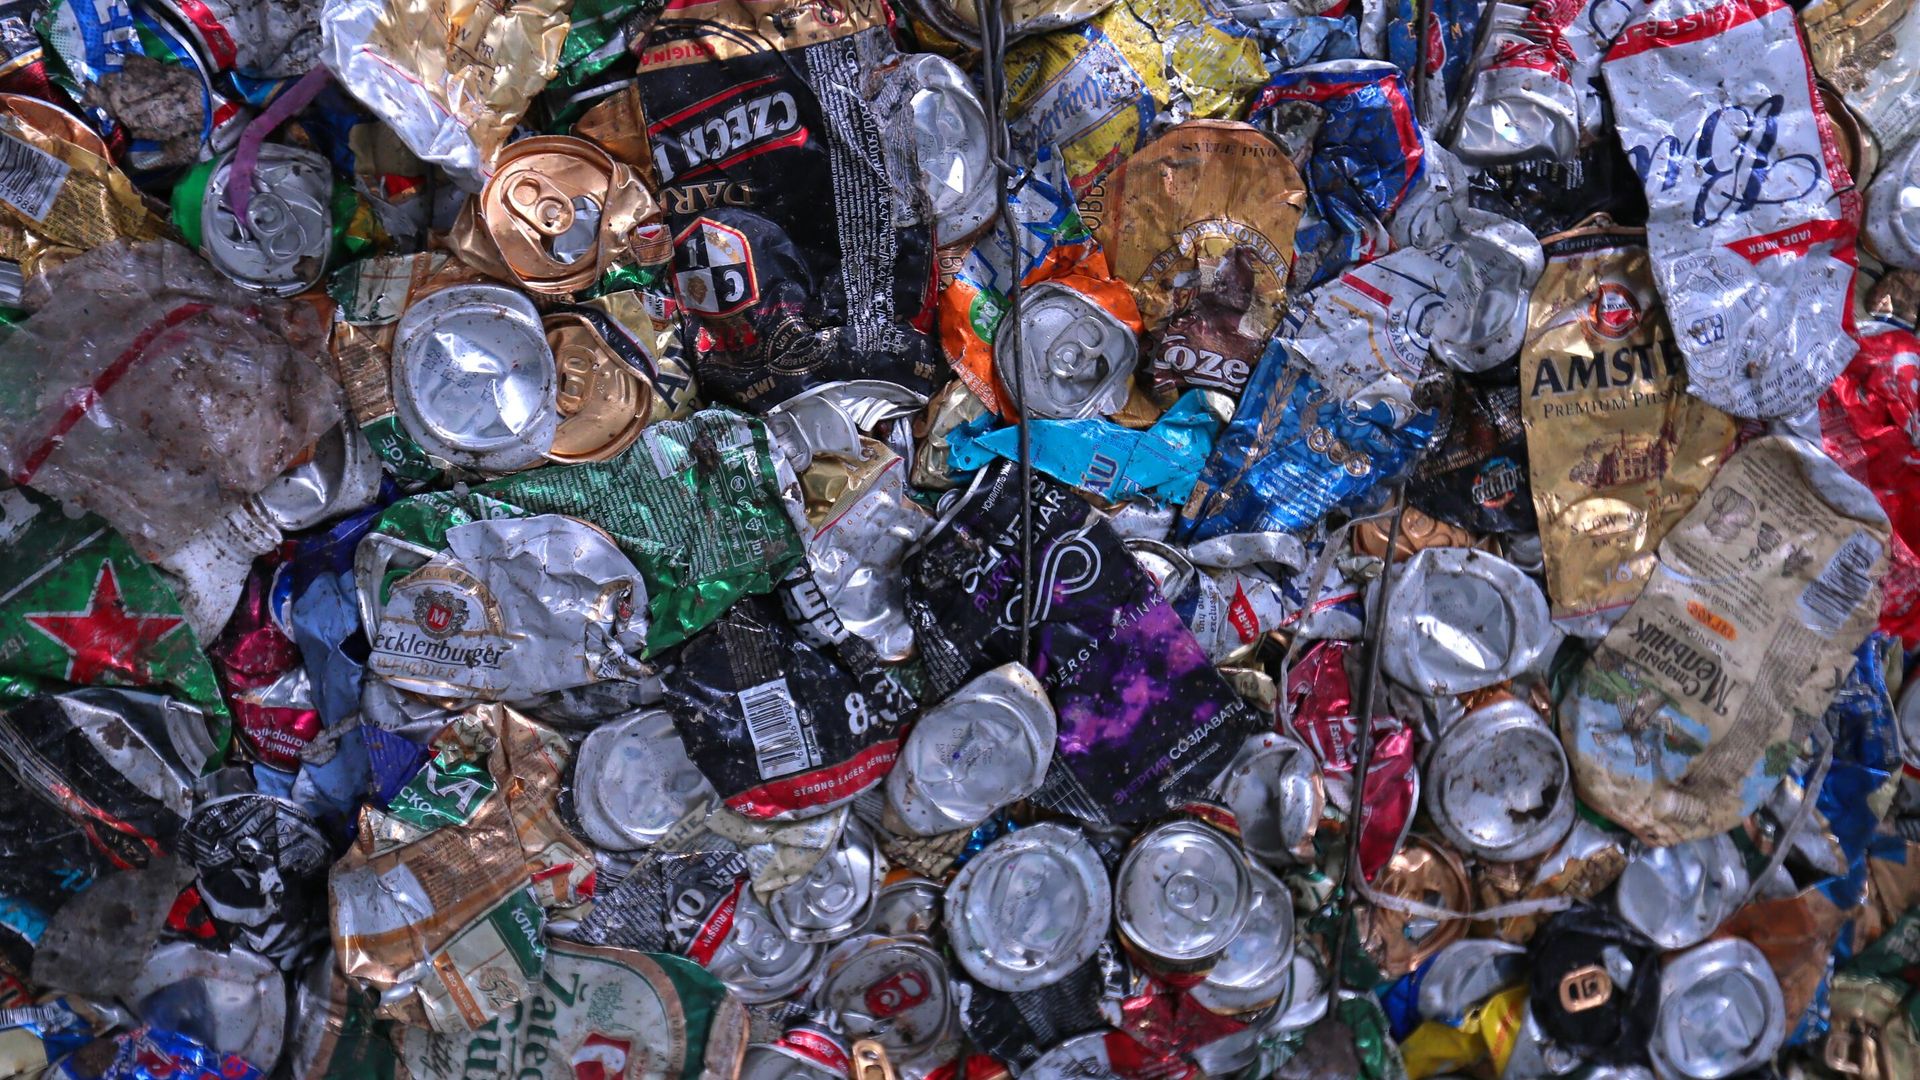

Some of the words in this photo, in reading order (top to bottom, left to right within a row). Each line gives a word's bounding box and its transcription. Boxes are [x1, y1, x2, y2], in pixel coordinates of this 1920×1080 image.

[643, 42, 716, 67] ORIGINA
[680, 91, 798, 166] CZECH
[1747, 239, 1779, 255] MARK
[1543, 388, 1627, 417] PREMIUM
[428, 607, 449, 627] M
[373, 631, 504, 672] ecklenburger
[1042, 638, 1102, 691] NERGY
[1170, 700, 1245, 759] СОЗДАВАТЬ
[792, 773, 836, 804] STRONG
